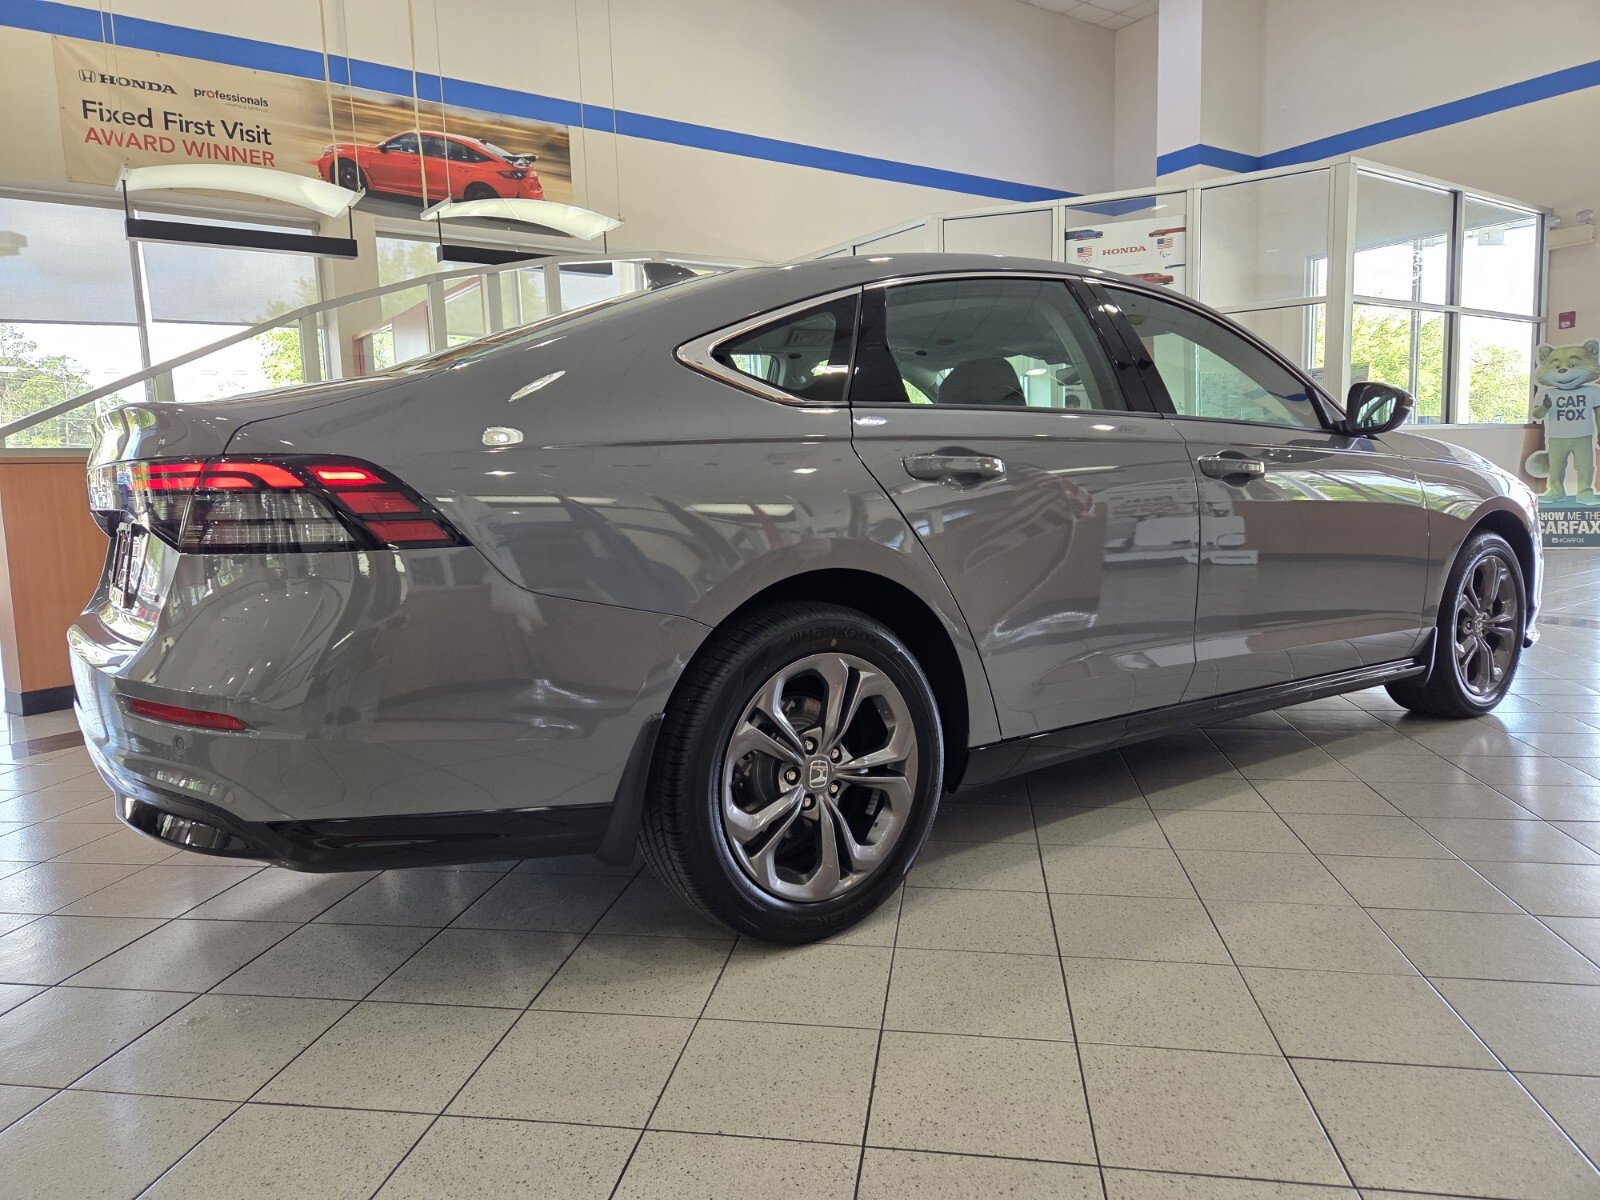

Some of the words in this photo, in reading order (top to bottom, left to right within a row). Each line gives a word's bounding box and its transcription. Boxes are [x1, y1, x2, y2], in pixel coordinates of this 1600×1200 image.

[98, 73, 178, 94] HONDA
[194, 88, 269, 107] professionals
[81, 99, 154, 129] Fixed
[163, 111, 216, 137] First
[220, 119, 272, 146] Visit
[84, 126, 176, 154] AWARD
[181, 139, 276, 168] WINNER
[1102, 246, 1147, 255] HONDA
[1556, 394, 1586, 408] CAR
[1557, 410, 1586, 421] FOX
[1537, 511, 1565, 520] SHOW
[1567, 511, 1582, 520] ME
[1584, 511, 1600, 520] THE
[1540, 520, 1600, 535] CARFAX
